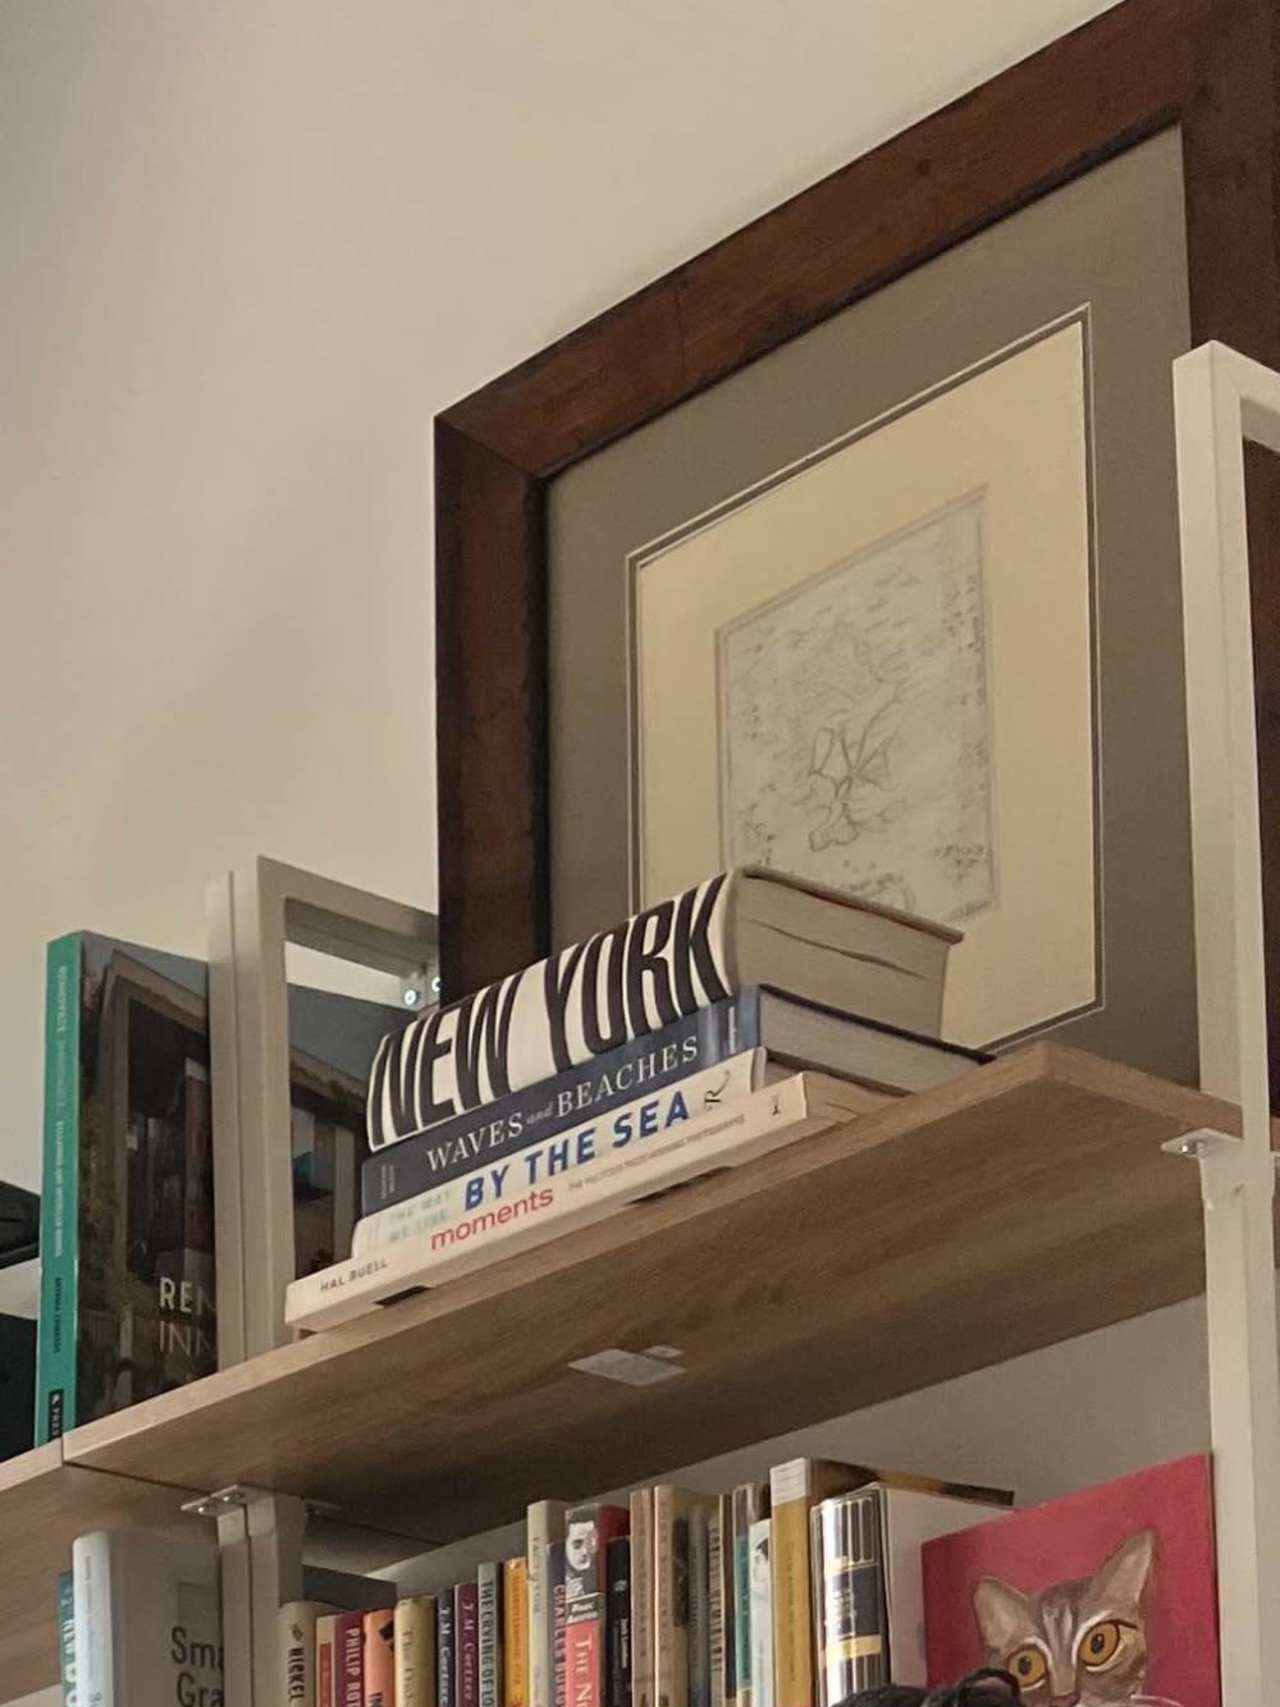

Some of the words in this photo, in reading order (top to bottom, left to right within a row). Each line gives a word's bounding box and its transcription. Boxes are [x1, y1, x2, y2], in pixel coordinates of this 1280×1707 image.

[367, 971, 524, 1151] NEW
[545, 874, 733, 1073] YORK
[426, 1112, 524, 1174] WAVES
[527, 1104, 554, 1126] and
[556, 1035, 699, 1118] BEACHES
[464, 1164, 510, 1210] BY
[526, 1126, 597, 1184] THE
[611, 1090, 689, 1148] SEA
[429, 1187, 554, 1251] moments
[320, 1273, 346, 1293] HAL
[349, 1256, 389, 1282] BUELL
[478, 1580, 493, 1609] THE
[553, 1584, 565, 1658] CHARLES
[344, 1628, 361, 1676] PHILIP
[478, 1610, 494, 1666] CRYING
[573, 1634, 591, 1678] THE
[288, 1646, 305, 1703] NICKEL
